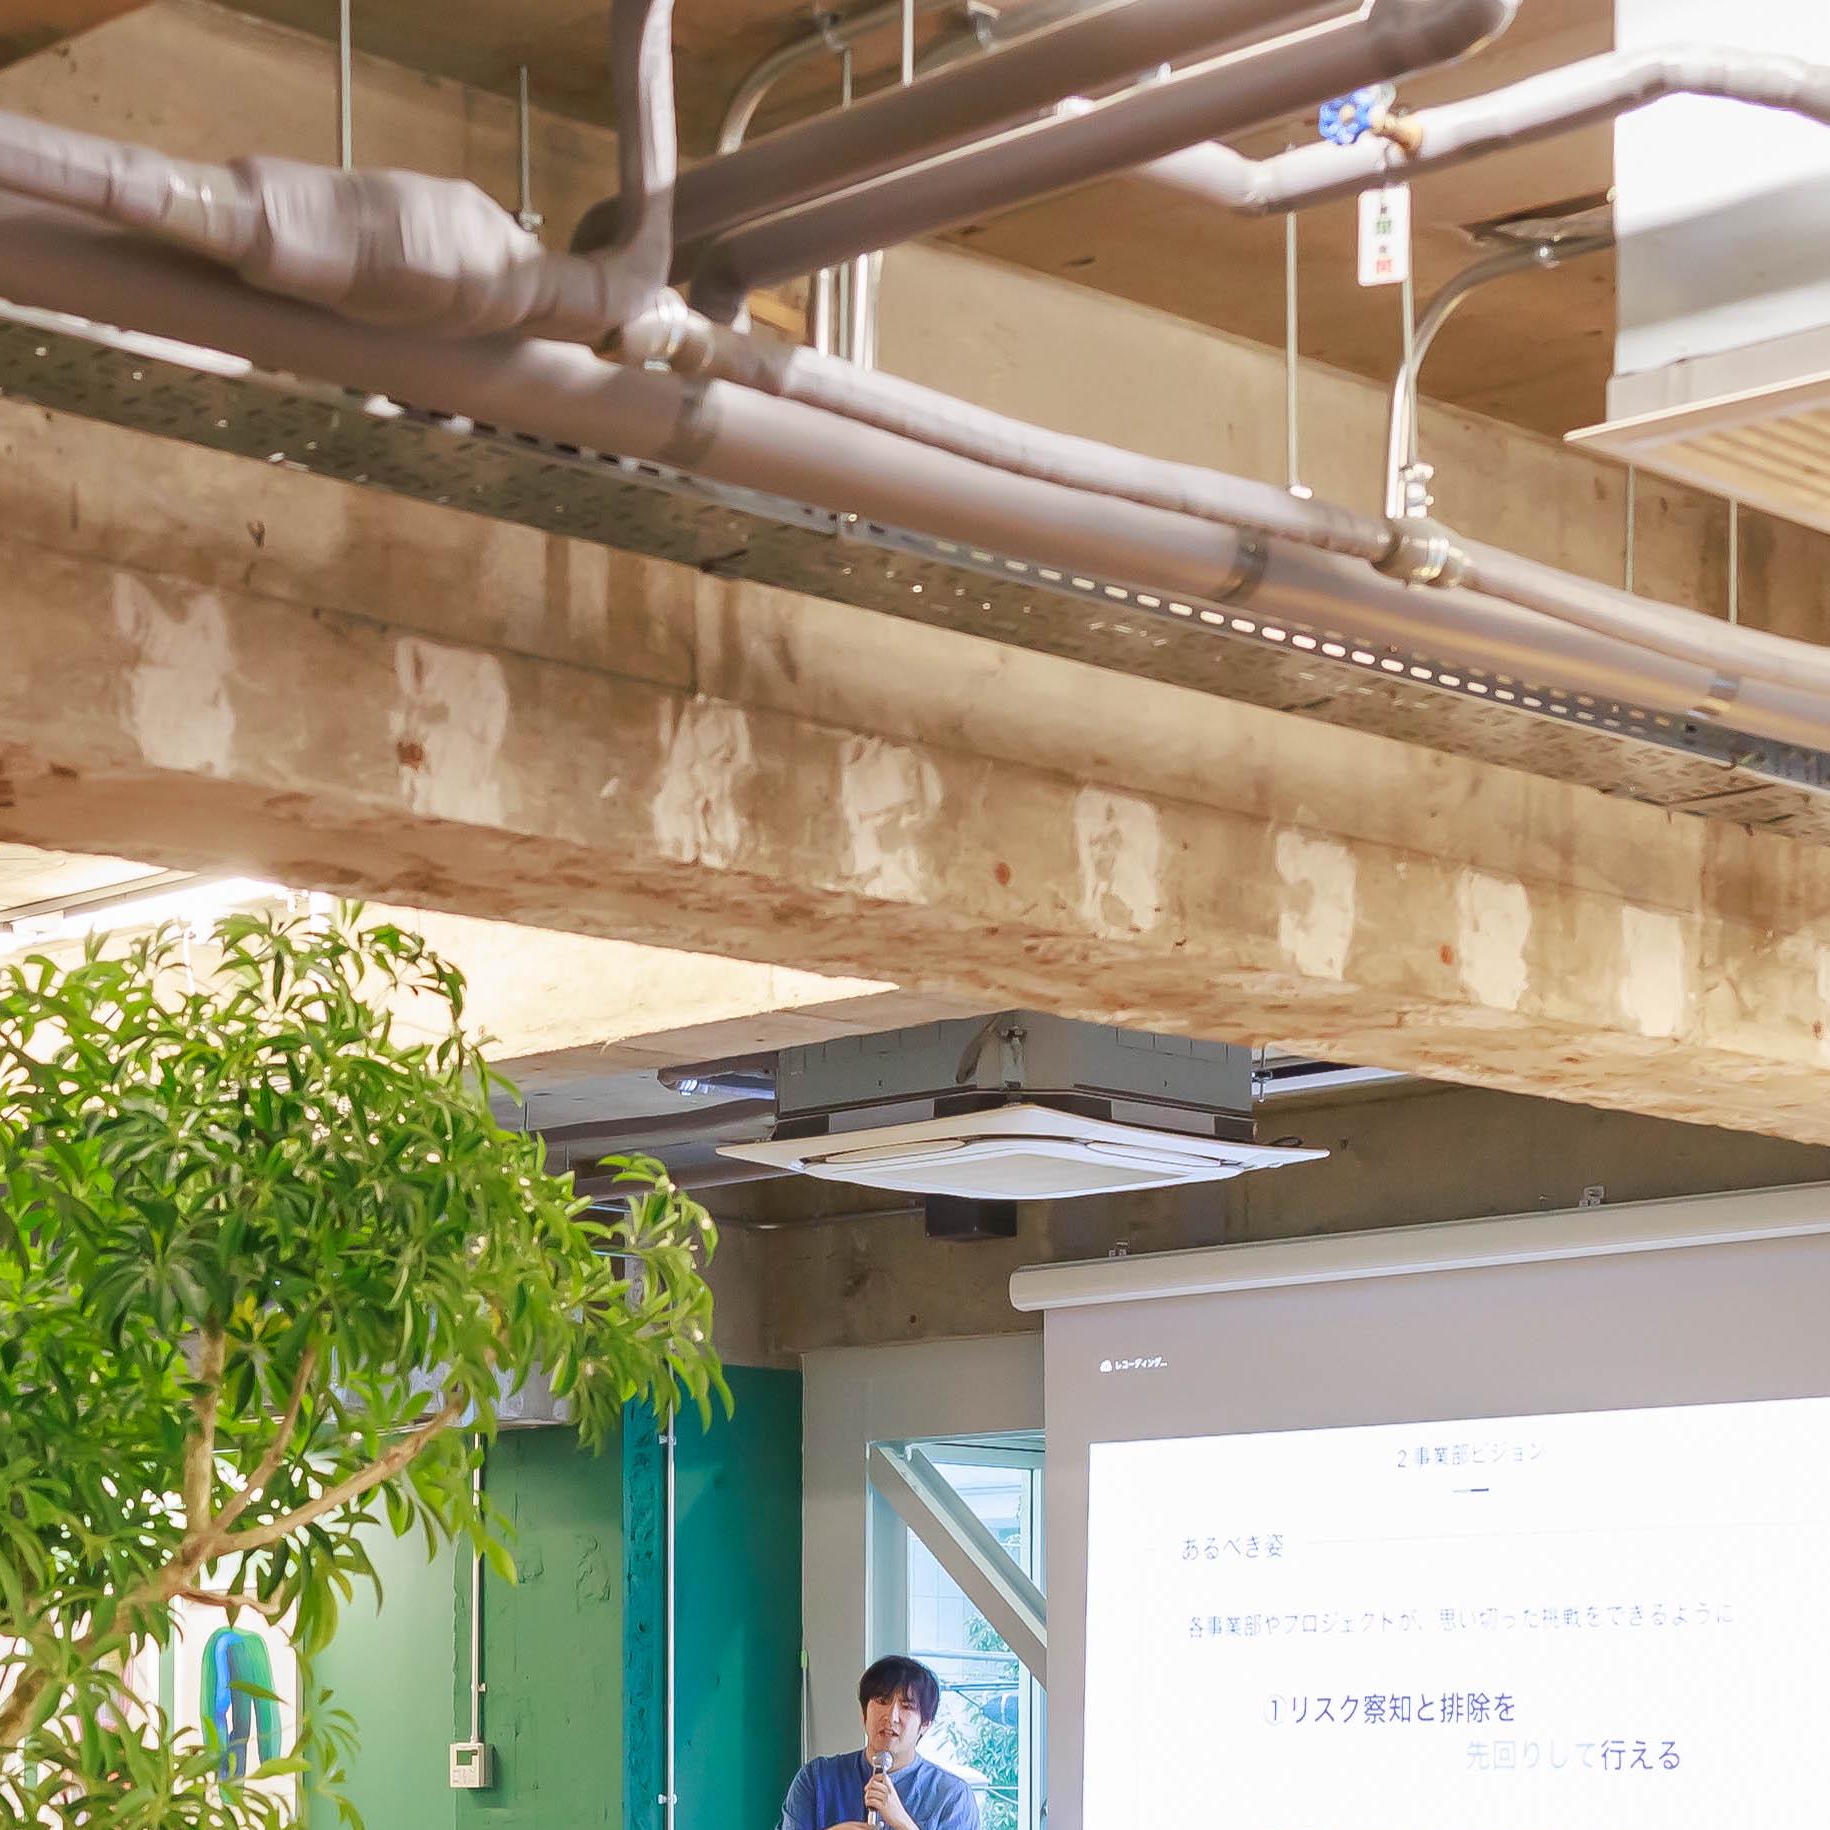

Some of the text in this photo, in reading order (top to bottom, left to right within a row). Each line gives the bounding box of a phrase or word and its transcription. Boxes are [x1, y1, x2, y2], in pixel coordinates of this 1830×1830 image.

[1182, 1535, 1283, 1560] あるべき姿
[1467, 1739, 1681, 1770] 先回りして行える
